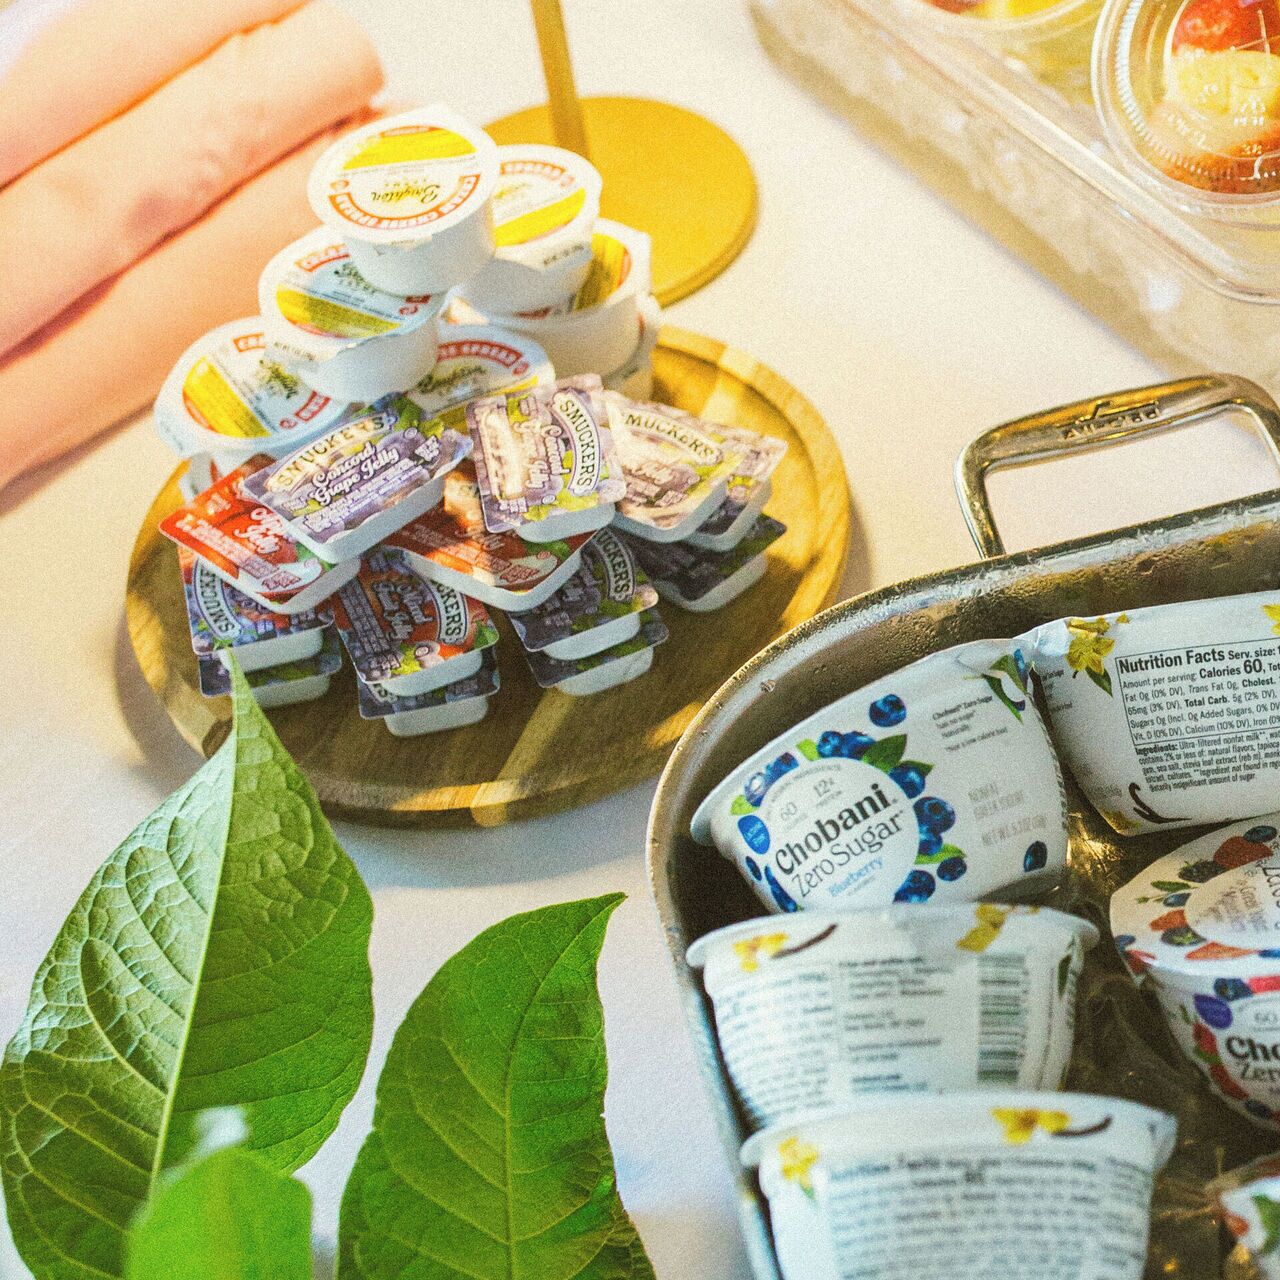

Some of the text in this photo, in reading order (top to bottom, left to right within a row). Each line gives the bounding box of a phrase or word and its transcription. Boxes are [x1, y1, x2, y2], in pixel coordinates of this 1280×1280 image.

[559, 399, 596, 487] SMUCKER'S
[622, 412, 714, 460] MUCKER'S
[311, 441, 376, 489] Concord
[314, 472, 360, 506] Grape
[361, 447, 400, 480] Jelly
[1119, 653, 1183, 674] Nutrition
[1186, 648, 1226, 665] Facts
[1228, 650, 1252, 661] Serv.
[1254, 646, 1276, 657] size:
[1122, 678, 1150, 689] Amount
[1152, 676, 1165, 687] per
[1199, 666, 1241, 679] Calories
[1243, 658, 1266, 674] 60,
[1127, 706, 1148, 716] 65mg
[1184, 697, 1205, 707] Total
[1207, 695, 1230, 705] Carb.
[1232, 693, 1243, 703] 5g
[1189, 684, 1208, 694] Trans
[1211, 682, 1224, 691] Fat
[1242, 677, 1276, 688] Cholest.
[1130, 719, 1154, 729] Sugars
[1200, 709, 1224, 719] Added
[1185, 717, 1268, 735] Calcium Iron
[775, 783, 891, 875] Chobani
[791, 814, 902, 898] Zero Sugar
